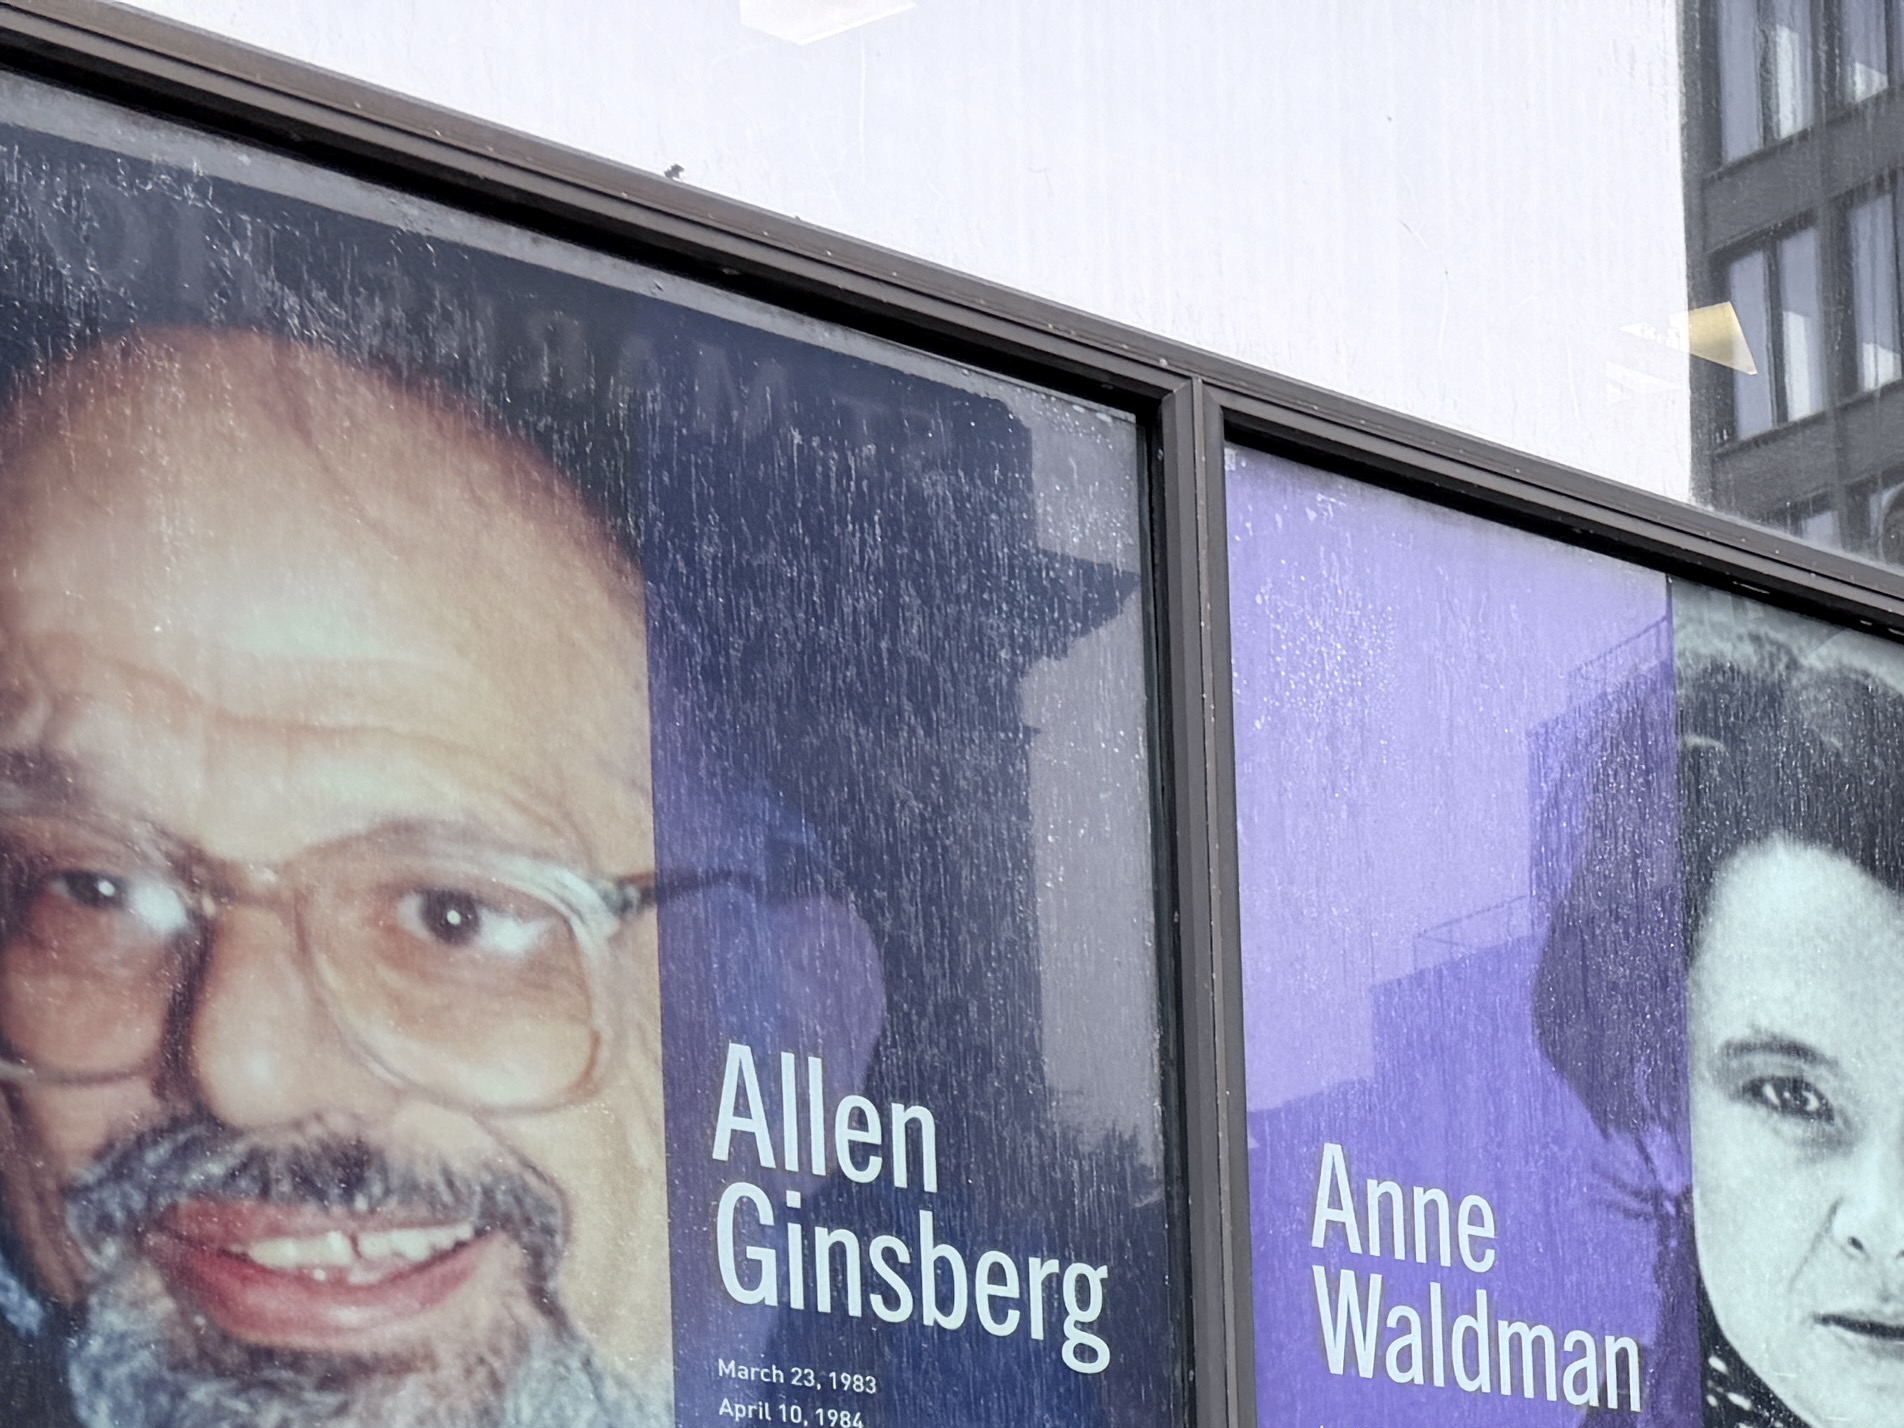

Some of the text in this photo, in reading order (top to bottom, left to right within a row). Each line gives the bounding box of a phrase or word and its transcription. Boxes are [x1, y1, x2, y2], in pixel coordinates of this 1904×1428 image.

[712, 1042, 938, 1194] Allen
[716, 1180, 1110, 1374] Ginsberg
[1311, 1142, 1496, 1273] Anne
[719, 1359, 876, 1394] March 23, 1983
[1312, 1264, 1641, 1413] Waldman
[719, 1398, 771, 1421] April
[779, 1404, 808, 1426] 10,
